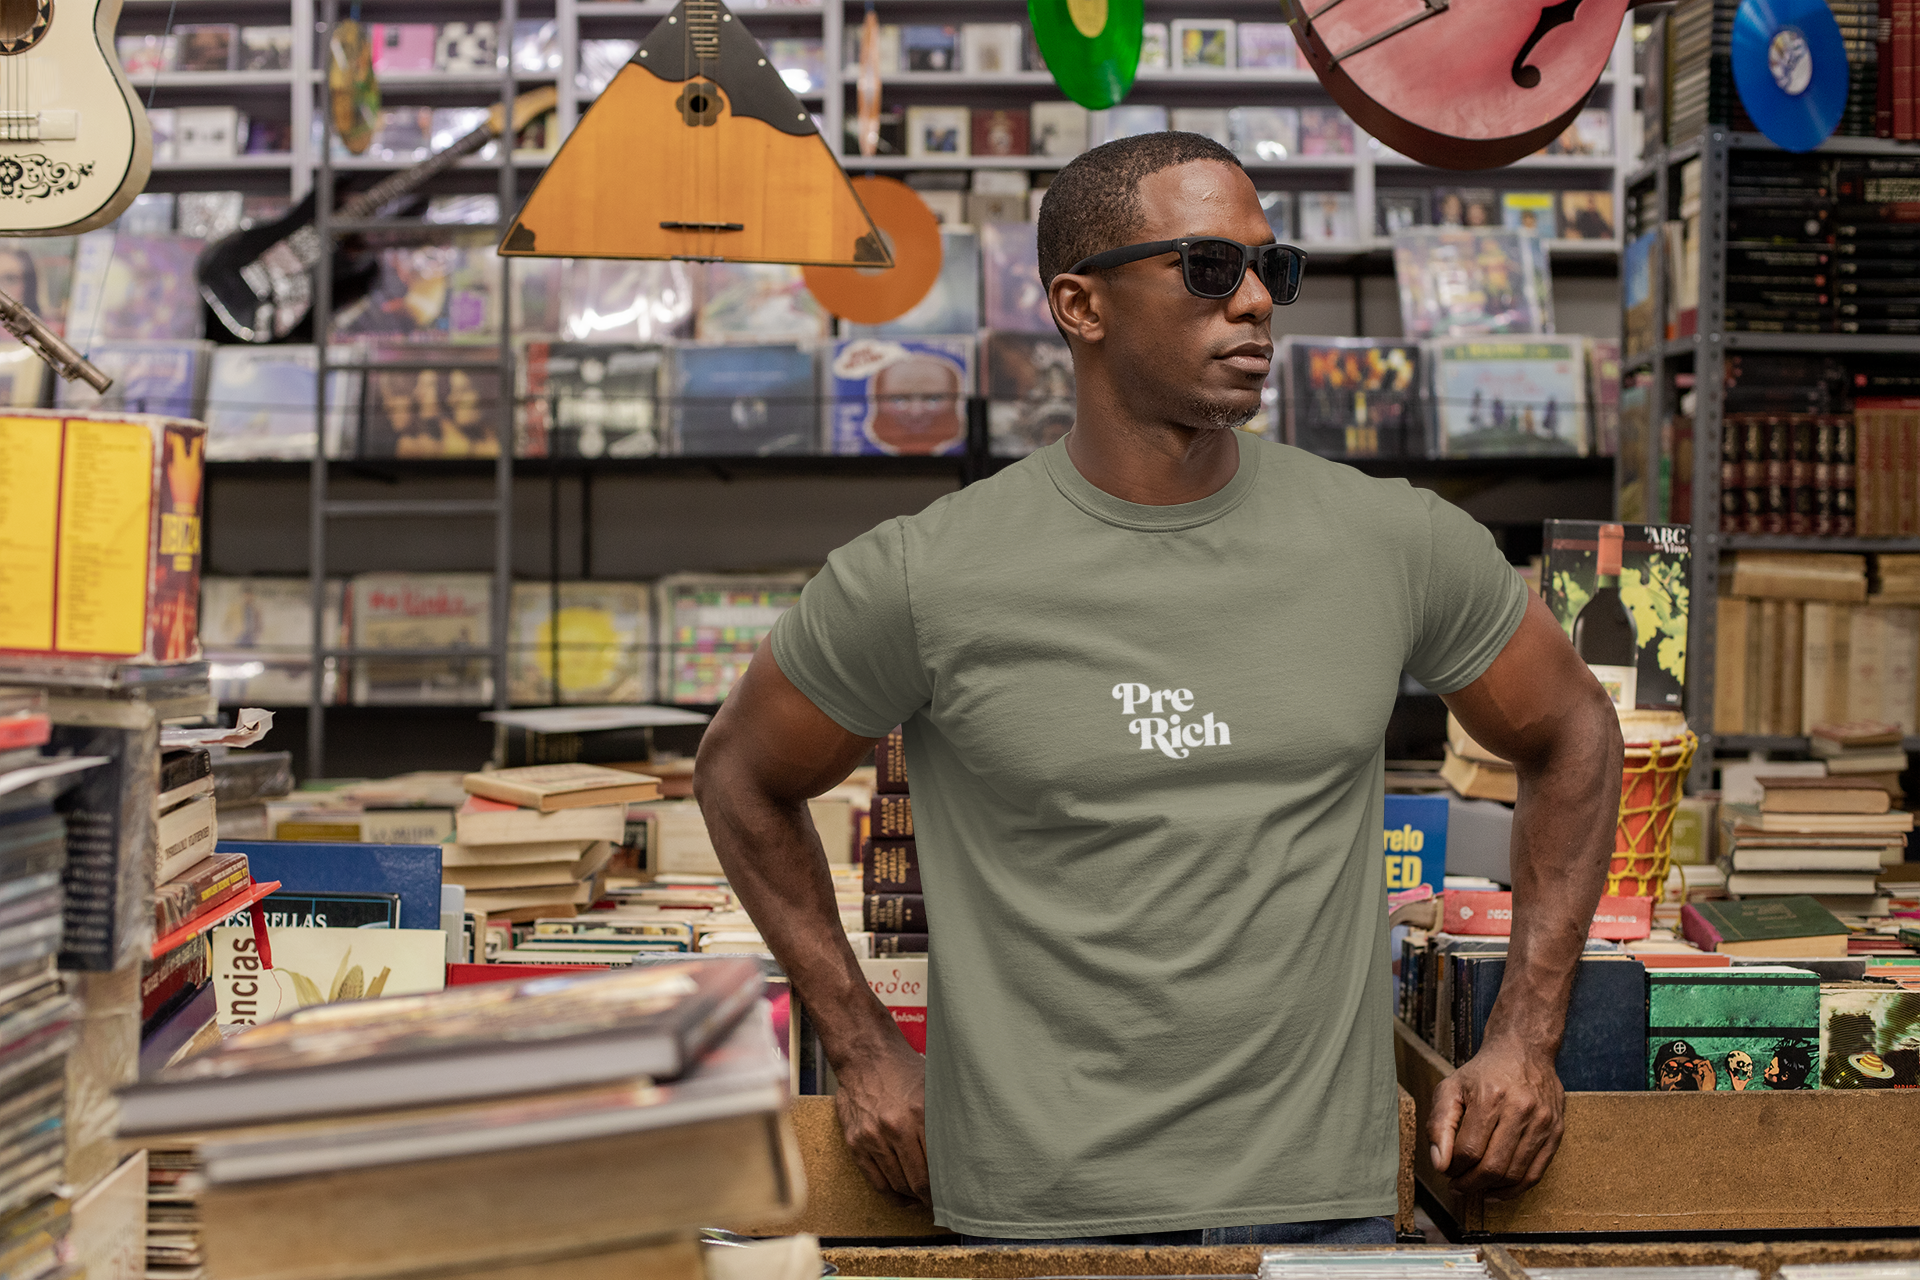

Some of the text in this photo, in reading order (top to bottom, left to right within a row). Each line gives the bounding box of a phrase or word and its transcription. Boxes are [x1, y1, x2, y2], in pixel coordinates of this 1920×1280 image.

[1647, 527, 1686, 545] ABC
[1112, 683, 1194, 714] Pre
[1129, 712, 1232, 759] Rich
[881, 797, 889, 835] AMADO
[874, 847, 882, 883] AMADO
[224, 911, 328, 928] ESELLAS
